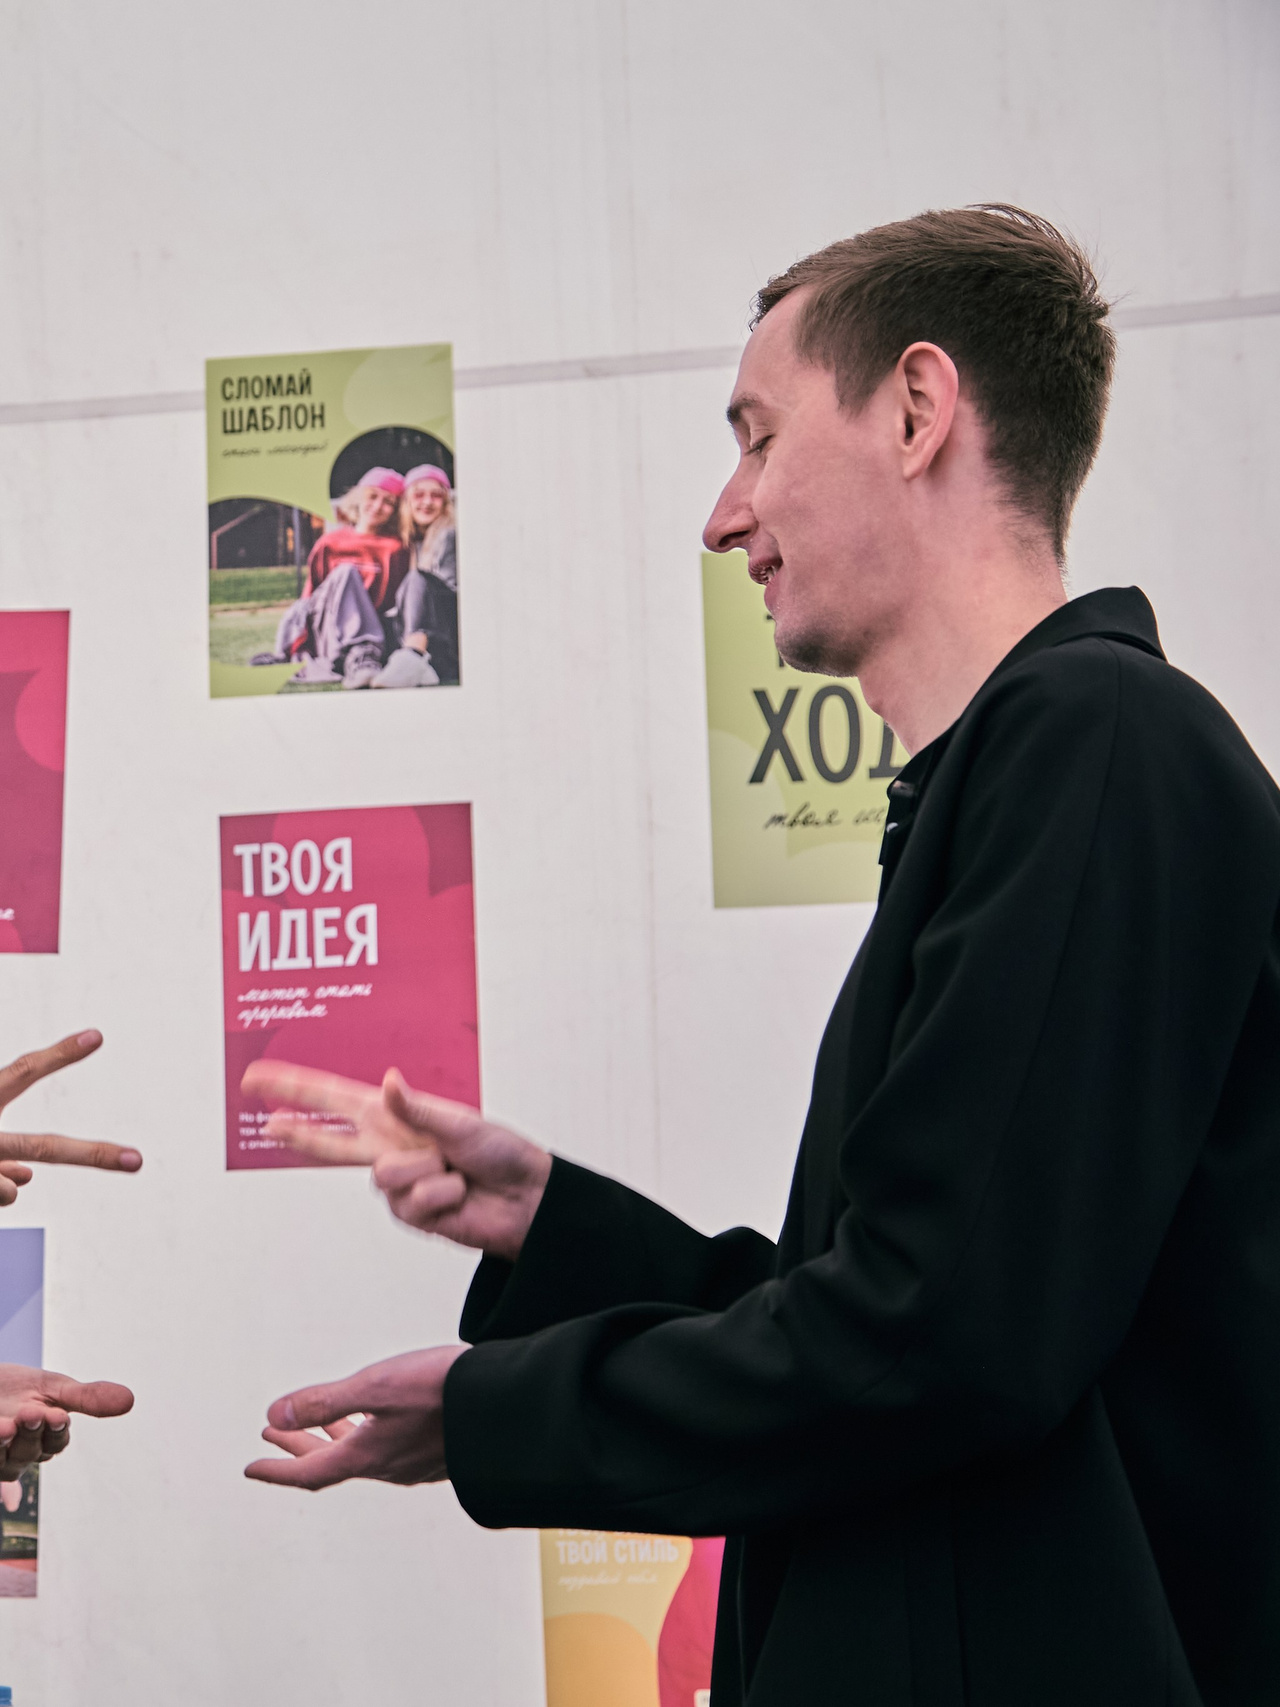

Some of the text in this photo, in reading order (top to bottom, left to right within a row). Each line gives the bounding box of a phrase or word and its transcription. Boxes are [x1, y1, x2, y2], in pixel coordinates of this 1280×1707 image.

[221, 368, 312, 401] СЛОМАЙ
[222, 402, 326, 434] ШАБЛОН
[233, 836, 353, 897] ТВОЯ
[237, 902, 379, 972] ИДЕЯ
[556, 1532, 680, 1565] ТВОЙ СТИЛЬ
